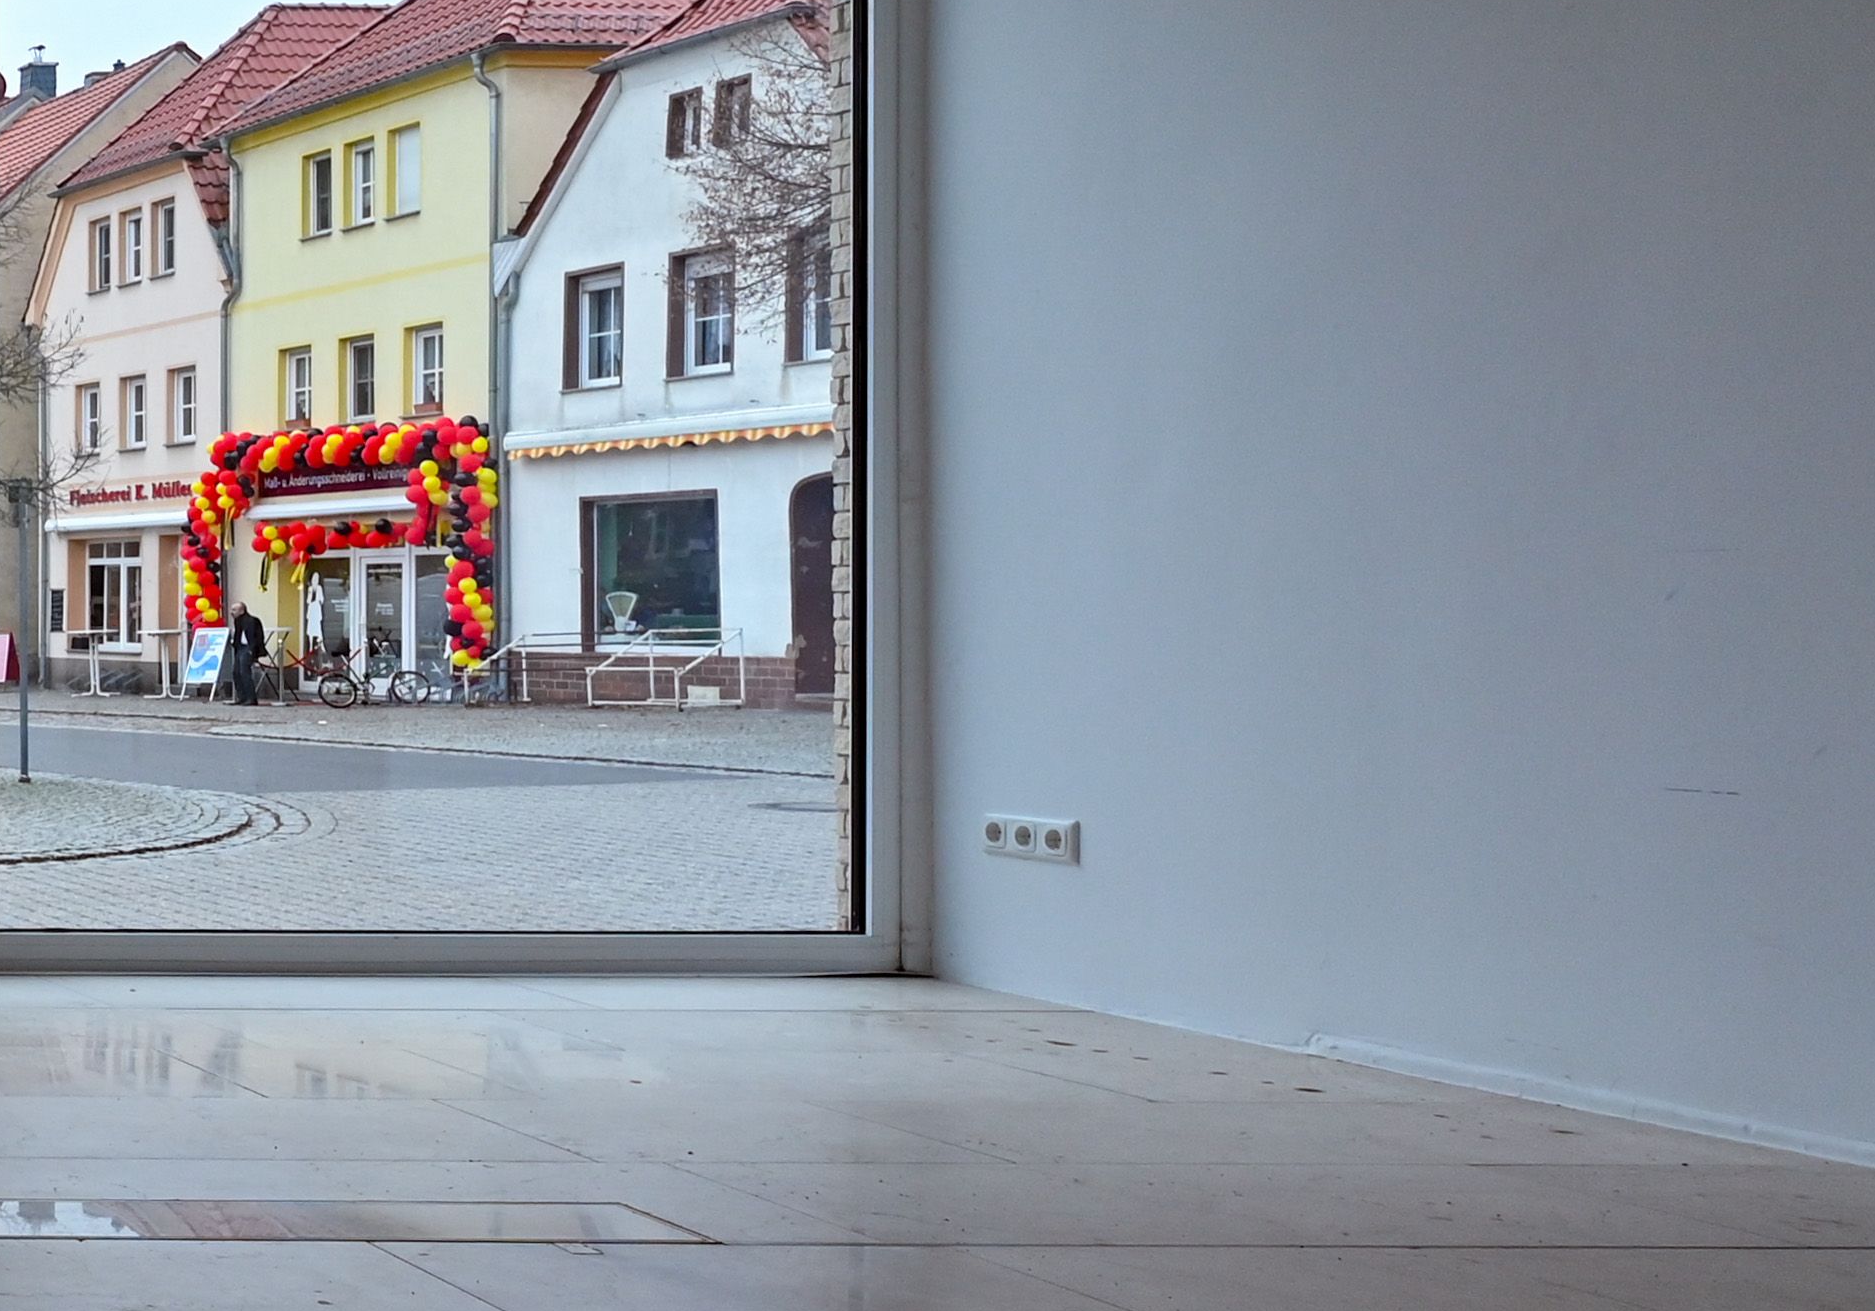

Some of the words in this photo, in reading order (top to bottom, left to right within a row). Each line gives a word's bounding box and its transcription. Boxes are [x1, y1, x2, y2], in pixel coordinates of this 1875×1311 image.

[289, 469, 366, 488] Änderungsschneiderei
[372, 466, 408, 482] Vollreinig
[69, 485, 131, 507] Fleischerei
[134, 484, 148, 500] K.
